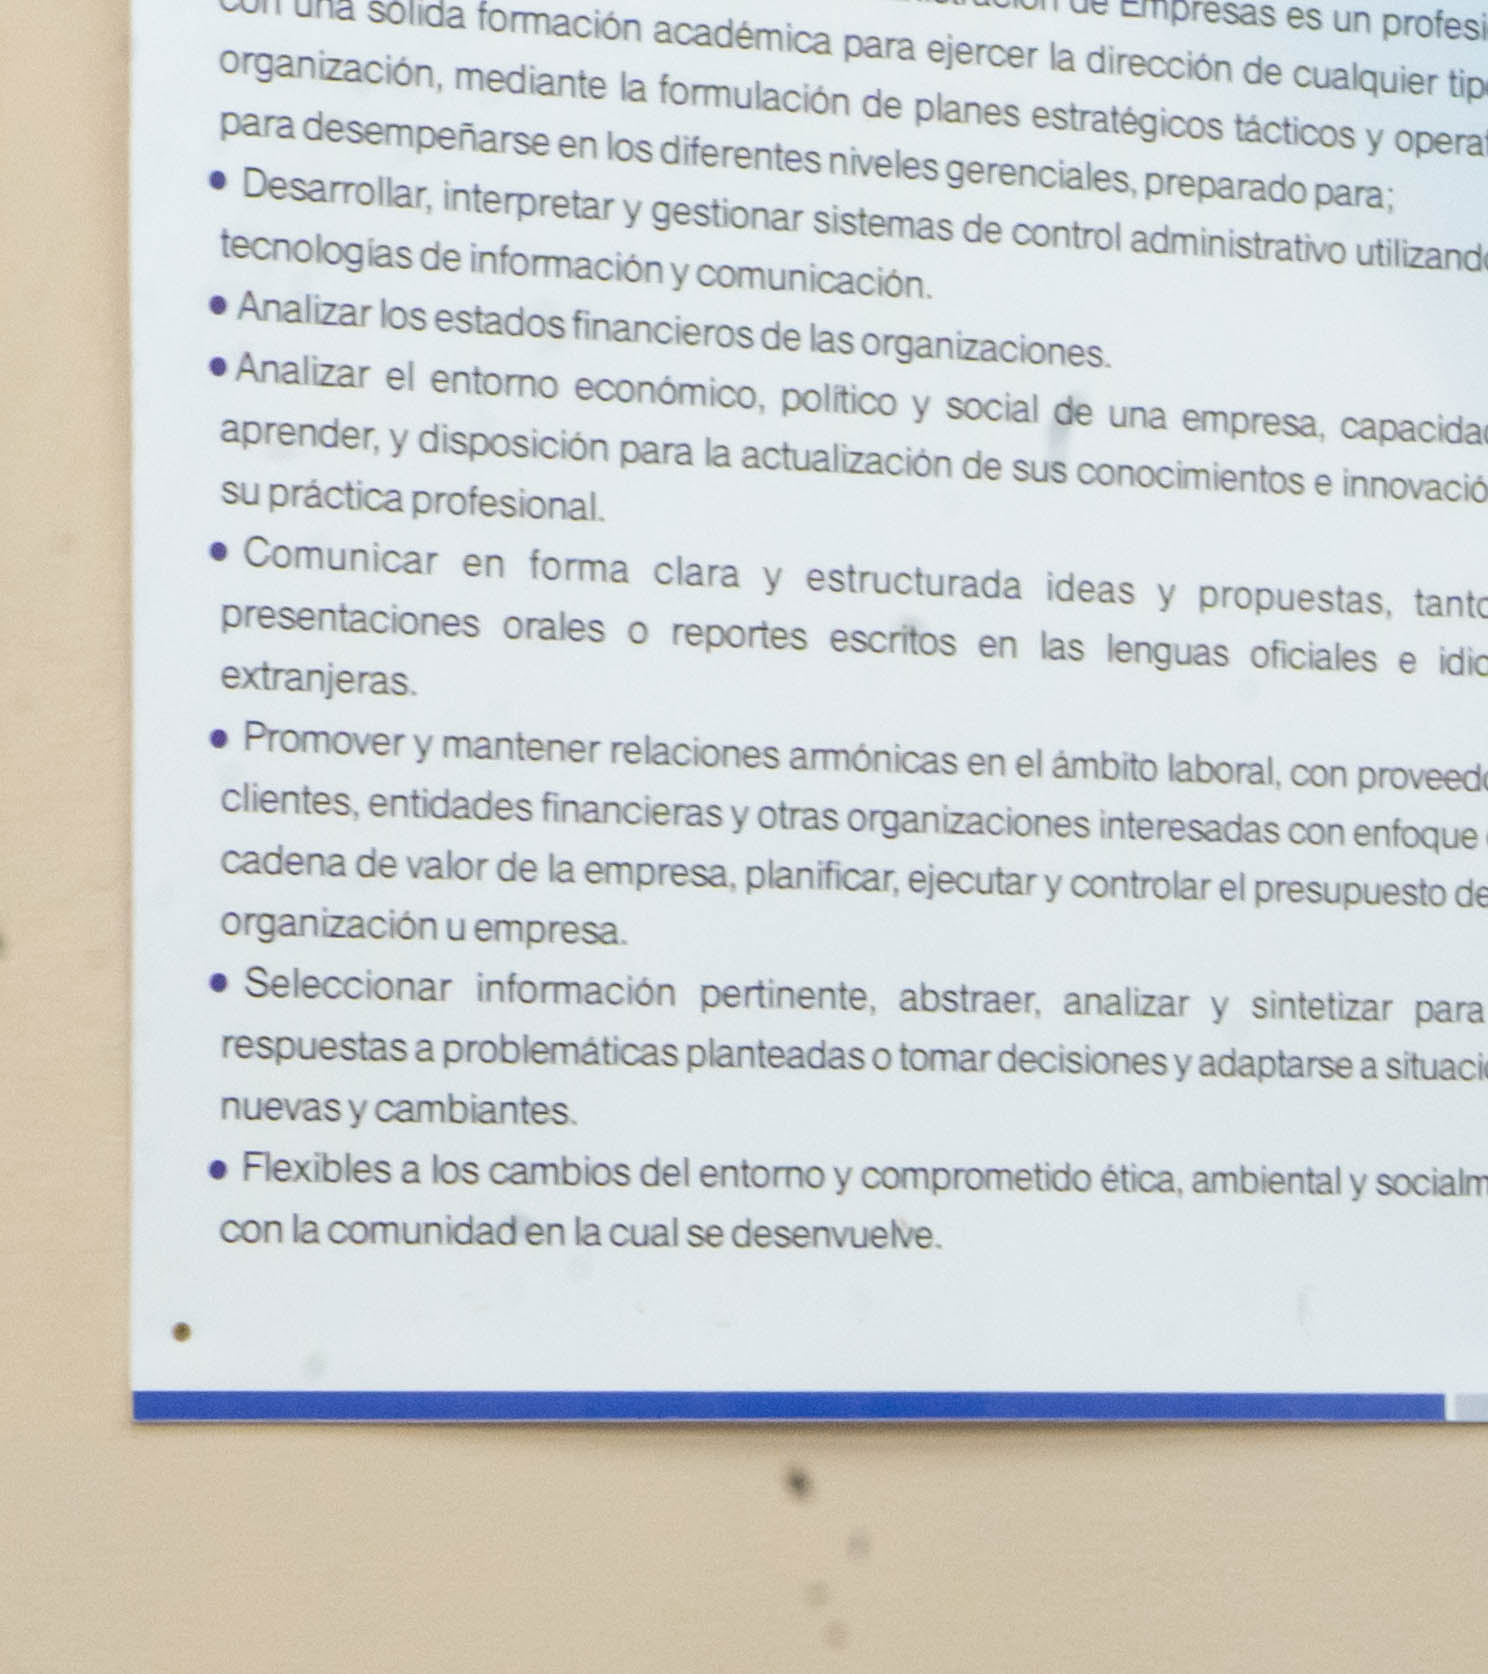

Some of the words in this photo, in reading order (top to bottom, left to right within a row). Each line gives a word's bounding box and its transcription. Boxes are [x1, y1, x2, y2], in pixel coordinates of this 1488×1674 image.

[218, 48, 443, 94] organización,
[454, 63, 608, 101] mediante
[620, 69, 648, 104] la
[657, 72, 851, 117] formulación
[861, 87, 903, 120] de
[914, 91, 1022, 129] planes
[1031, 101, 1225, 144] estratégicos
[1233, 112, 1357, 150] tácticos
[1364, 127, 1385, 158] y
[242, 165, 433, 215] Desarrollar,
[443, 179, 616, 223] interpretar
[621, 198, 644, 230] y
[650, 197, 805, 233] gestionar
[812, 203, 955, 243] sistemas
[961, 212, 1004, 246] de
[1010, 220, 1122, 252] control
[1129, 223, 1348, 265] administrativo
[219, 228, 414, 274] tecnologías
[419, 240, 462, 273] de
[470, 242, 664, 284] información
[670, 262, 690, 292] y
[695, 263, 934, 299] comunicación.
[236, 289, 374, 328] Analizar
[380, 297, 428, 332] los
[433, 304, 567, 340] estados
[571, 308, 755, 350] financieros
[759, 320, 802, 352] de
[809, 322, 855, 356] las
[860, 330, 1112, 369] organizaciones.
[220, 480, 261, 507] su
[267, 478, 405, 514] práctica
[411, 484, 606, 523] profesional.
[220, 660, 418, 701] extranjeras.
[243, 964, 454, 1003] Seleccionar
[476, 971, 677, 1008] información
[699, 977, 877, 1017] pertinente,
[898, 980, 1042, 1019] abstraer,
[1063, 985, 1191, 1018] analizar
[1210, 995, 1230, 1026] y
[1251, 989, 1394, 1023] sintetizar
[1414, 999, 1486, 1029] para
[220, 1096, 343, 1123] nuevas
[347, 1098, 369, 1130] y
[373, 1092, 578, 1126] cambiantes.
[219, 1218, 284, 1244] con
[292, 1212, 321, 1245] la
[327, 1214, 519, 1247] comunidad
[523, 1221, 566, 1247] en
[574, 1215, 603, 1247] la
[608, 1216, 679, 1248] cual
[686, 1223, 725, 1249] se
[730, 1217, 942, 1250] desenvuelve.
